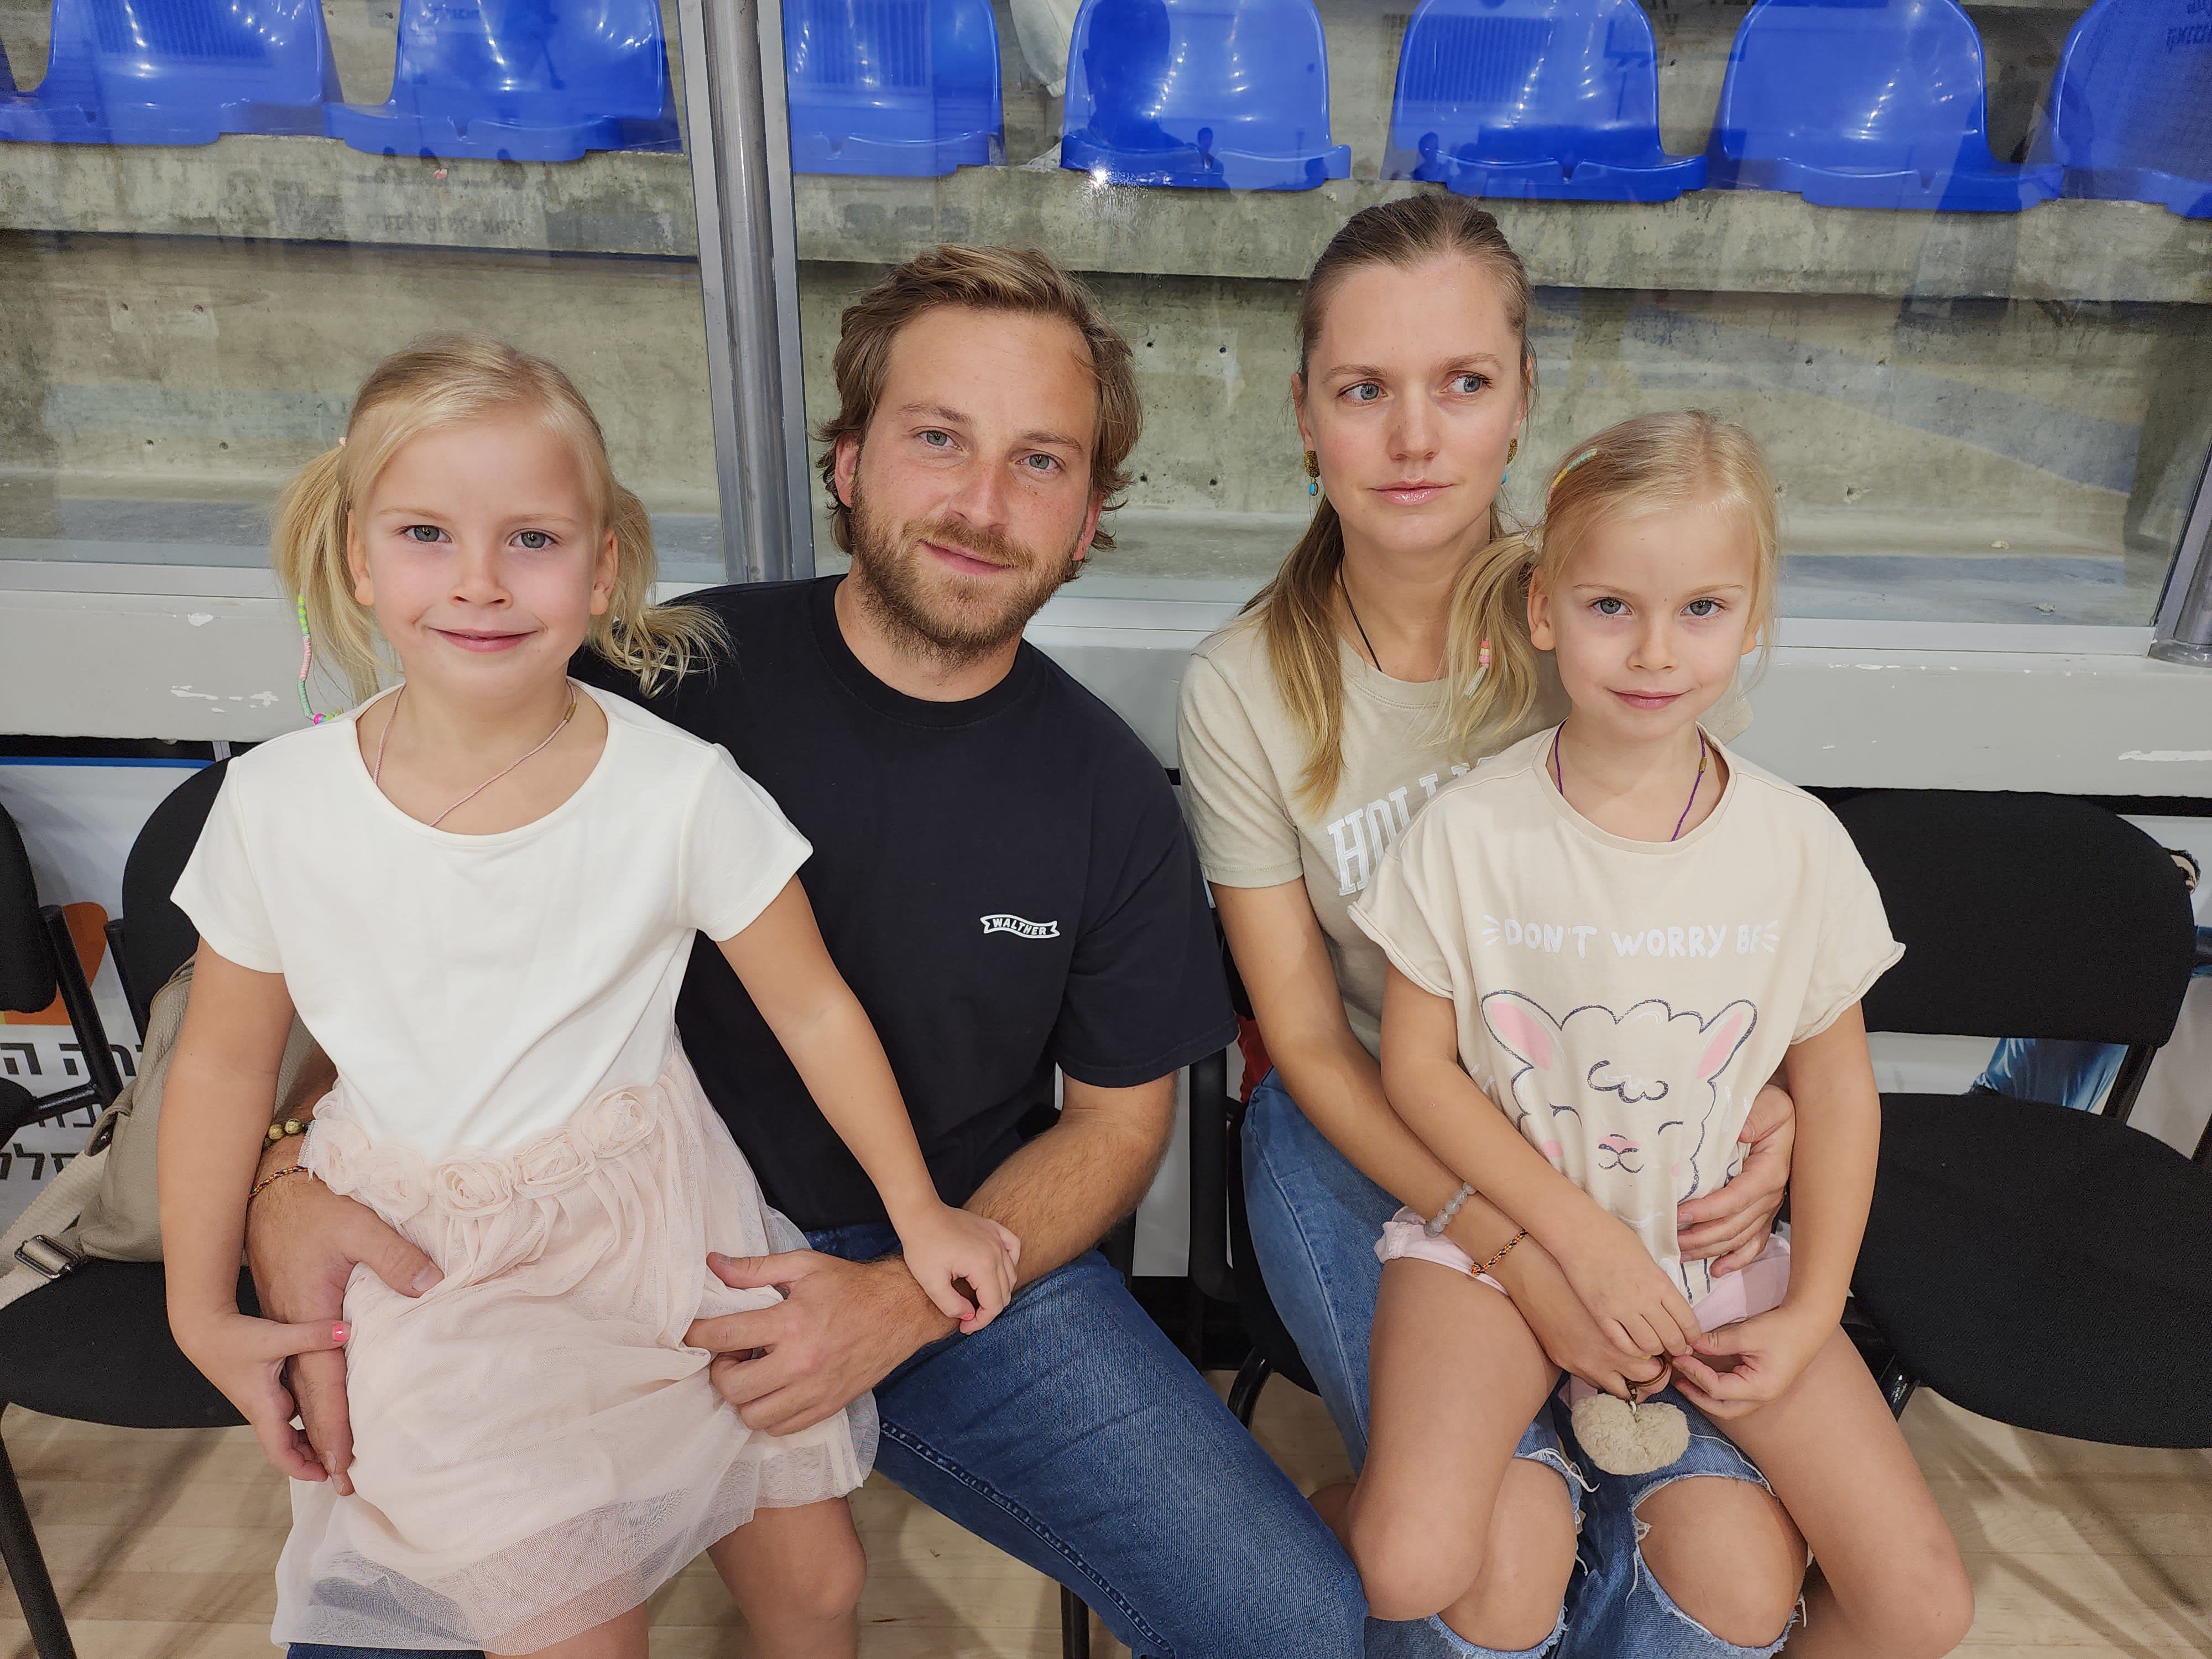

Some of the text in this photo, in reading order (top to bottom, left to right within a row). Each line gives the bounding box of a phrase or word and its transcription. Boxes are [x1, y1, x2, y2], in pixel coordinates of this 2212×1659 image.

[993, 918, 1047, 936] WALTHER
[1504, 919, 1597, 958] DON'T
[1611, 924, 1726, 958] WORRY
